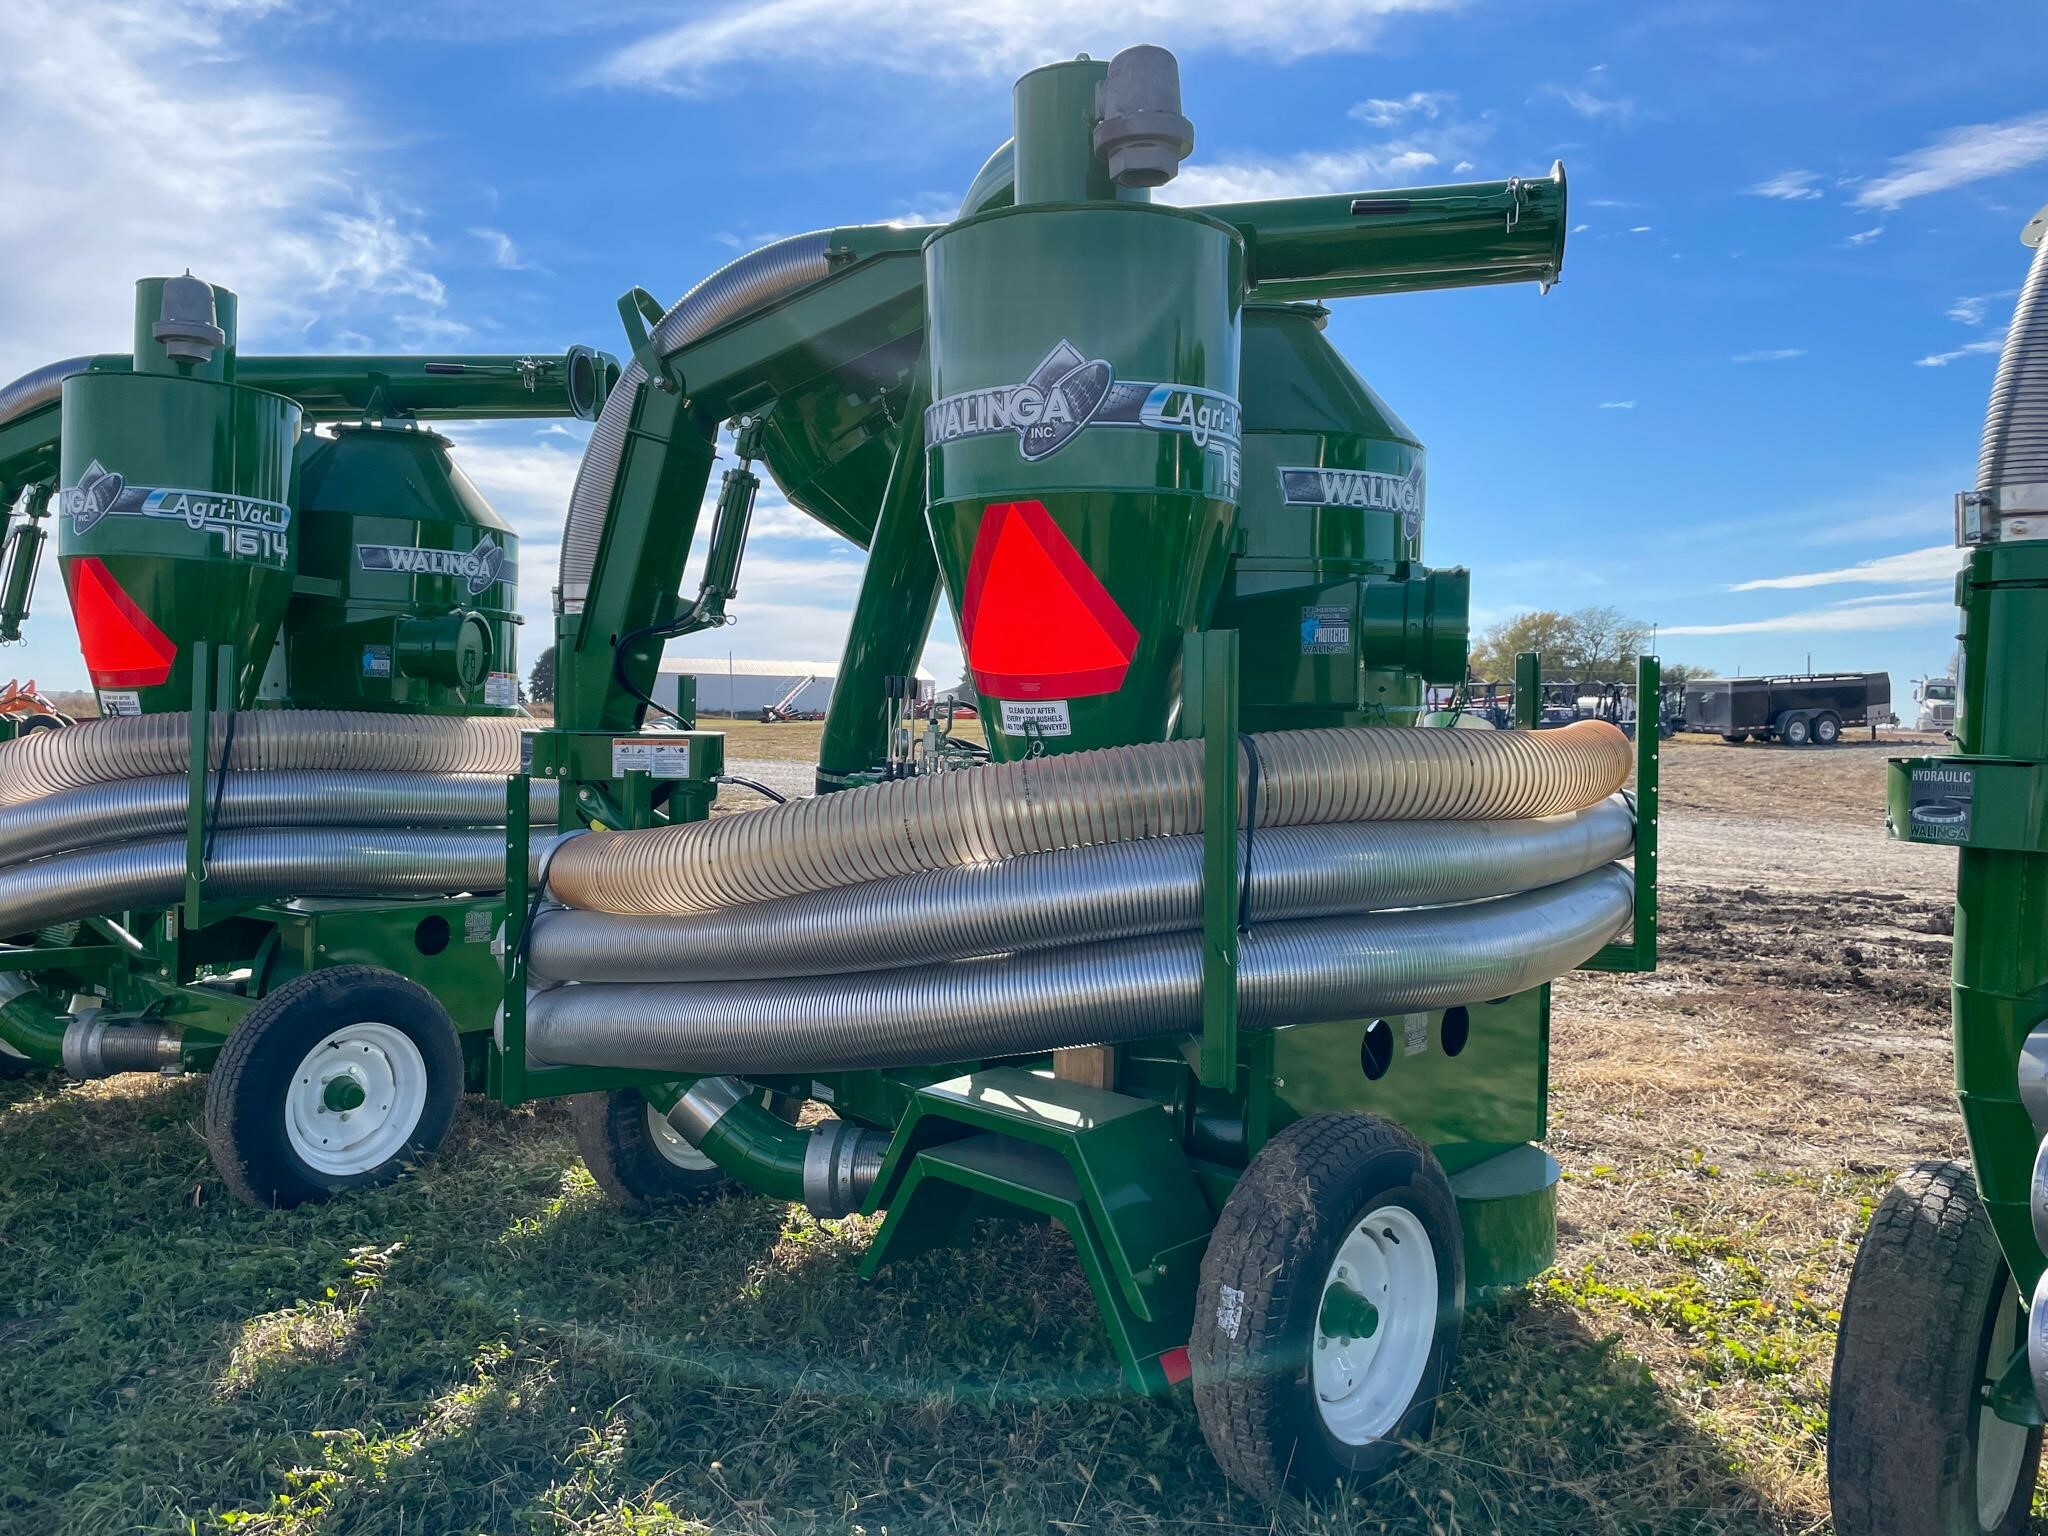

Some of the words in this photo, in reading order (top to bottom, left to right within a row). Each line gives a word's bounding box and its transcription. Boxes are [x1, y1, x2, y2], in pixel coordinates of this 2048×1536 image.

[929, 385, 1075, 441] WALINGA
[1030, 427, 1056, 438] INC.
[1320, 473, 1420, 513] WALINGA
[173, 494, 272, 530] Agri-Vac
[205, 524, 288, 565] 7614
[389, 549, 491, 577] WALINGA
[1314, 628, 1349, 643] PROTECTED
[1006, 714, 1021, 723] EVERY
[1036, 714, 1063, 723] BUSHELS
[1008, 706, 1024, 715] CLEAN
[1025, 707, 1036, 715] OUT
[1037, 706, 1056, 715] AFTER
[1038, 723, 1067, 731] ONVEYED
[1912, 769, 1971, 783] HYDRAULIC
[1910, 823, 1970, 841] WALINGA
